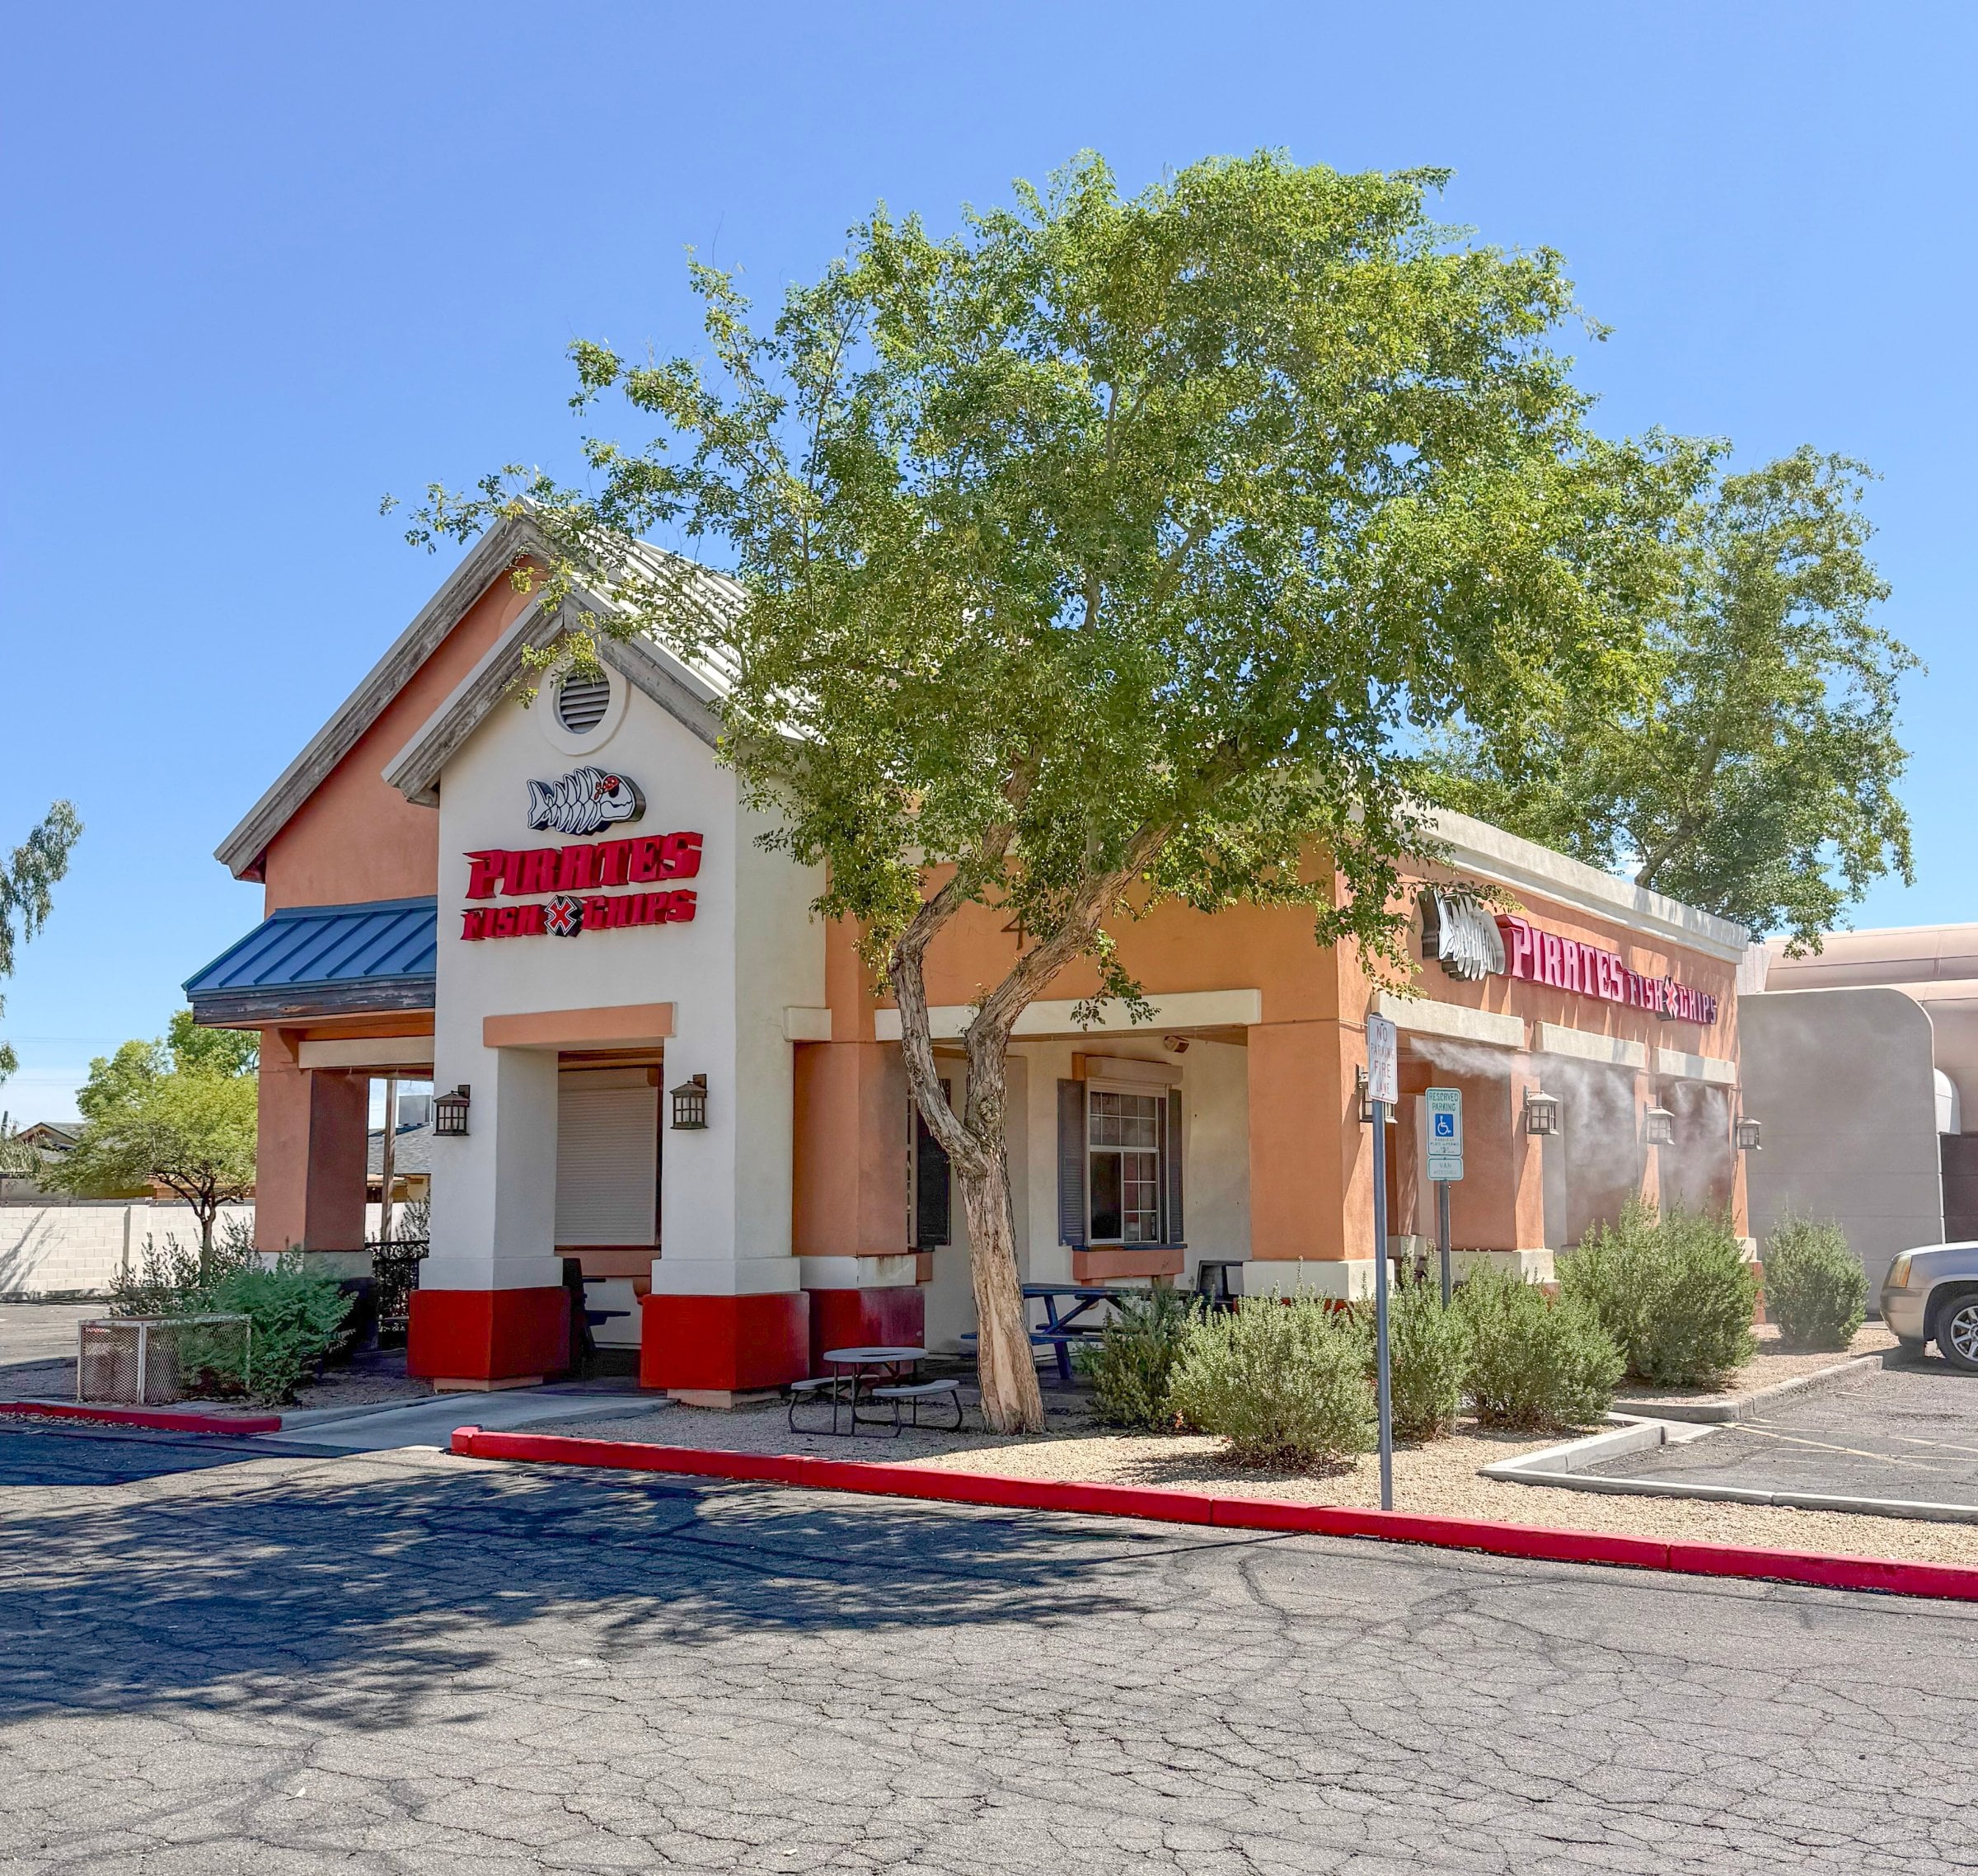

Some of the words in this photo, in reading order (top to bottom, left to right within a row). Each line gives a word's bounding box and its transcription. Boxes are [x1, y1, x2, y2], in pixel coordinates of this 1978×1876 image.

[462, 832, 703, 899] PIRATES
[461, 903, 547, 940] FISH
[580, 889, 697, 930] CHIPS
[1500, 914, 1624, 1003] PIRATES
[1627, 968, 1664, 1012] FISH
[1676, 983, 1718, 1024] CHIPS
[1376, 1025, 1388, 1042] NO
[1371, 1043, 1394, 1060] PARKING
[1374, 1060, 1391, 1078] FIRE
[1376, 1081, 1390, 1095] LANE
[1428, 1091, 1459, 1102] RESERVED
[1432, 1102, 1456, 1112] PARKING
